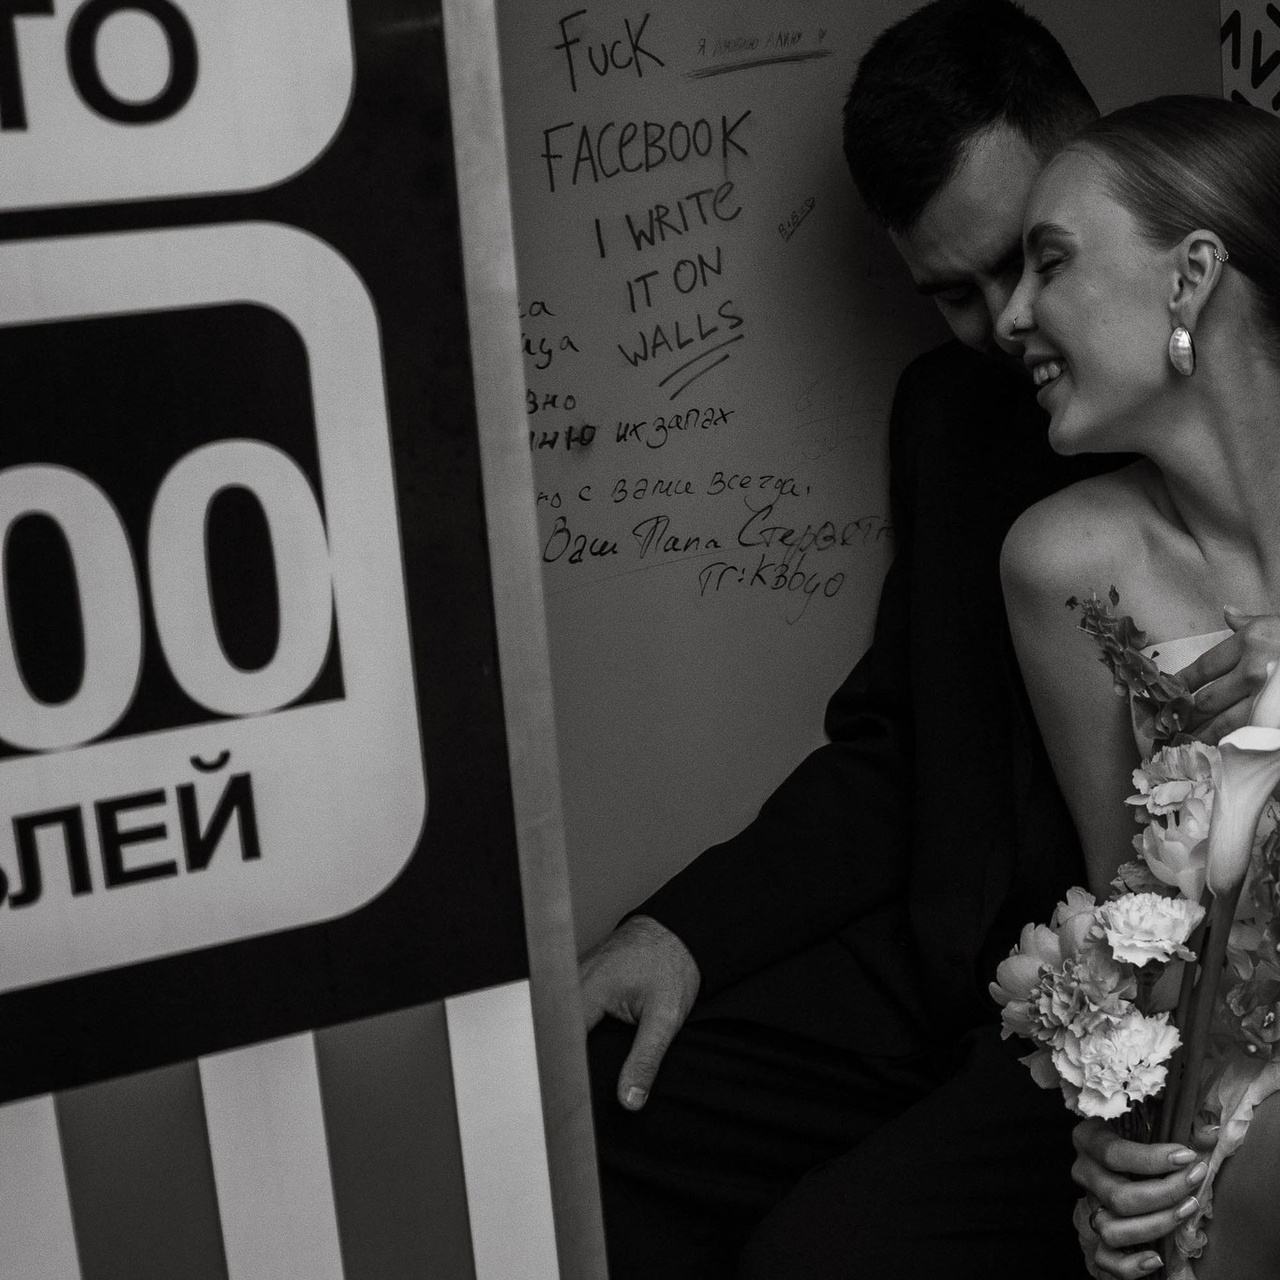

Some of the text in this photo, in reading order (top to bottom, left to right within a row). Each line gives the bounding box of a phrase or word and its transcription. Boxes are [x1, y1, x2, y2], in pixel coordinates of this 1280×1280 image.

[592, 217, 606, 259] I
[626, 245, 723, 313] IT ON
[617, 299, 745, 368] WALLS
[578, 485, 593, 502] с
[0, 437, 334, 754] 00
[0, 749, 261, 910] ЛЕЙ
